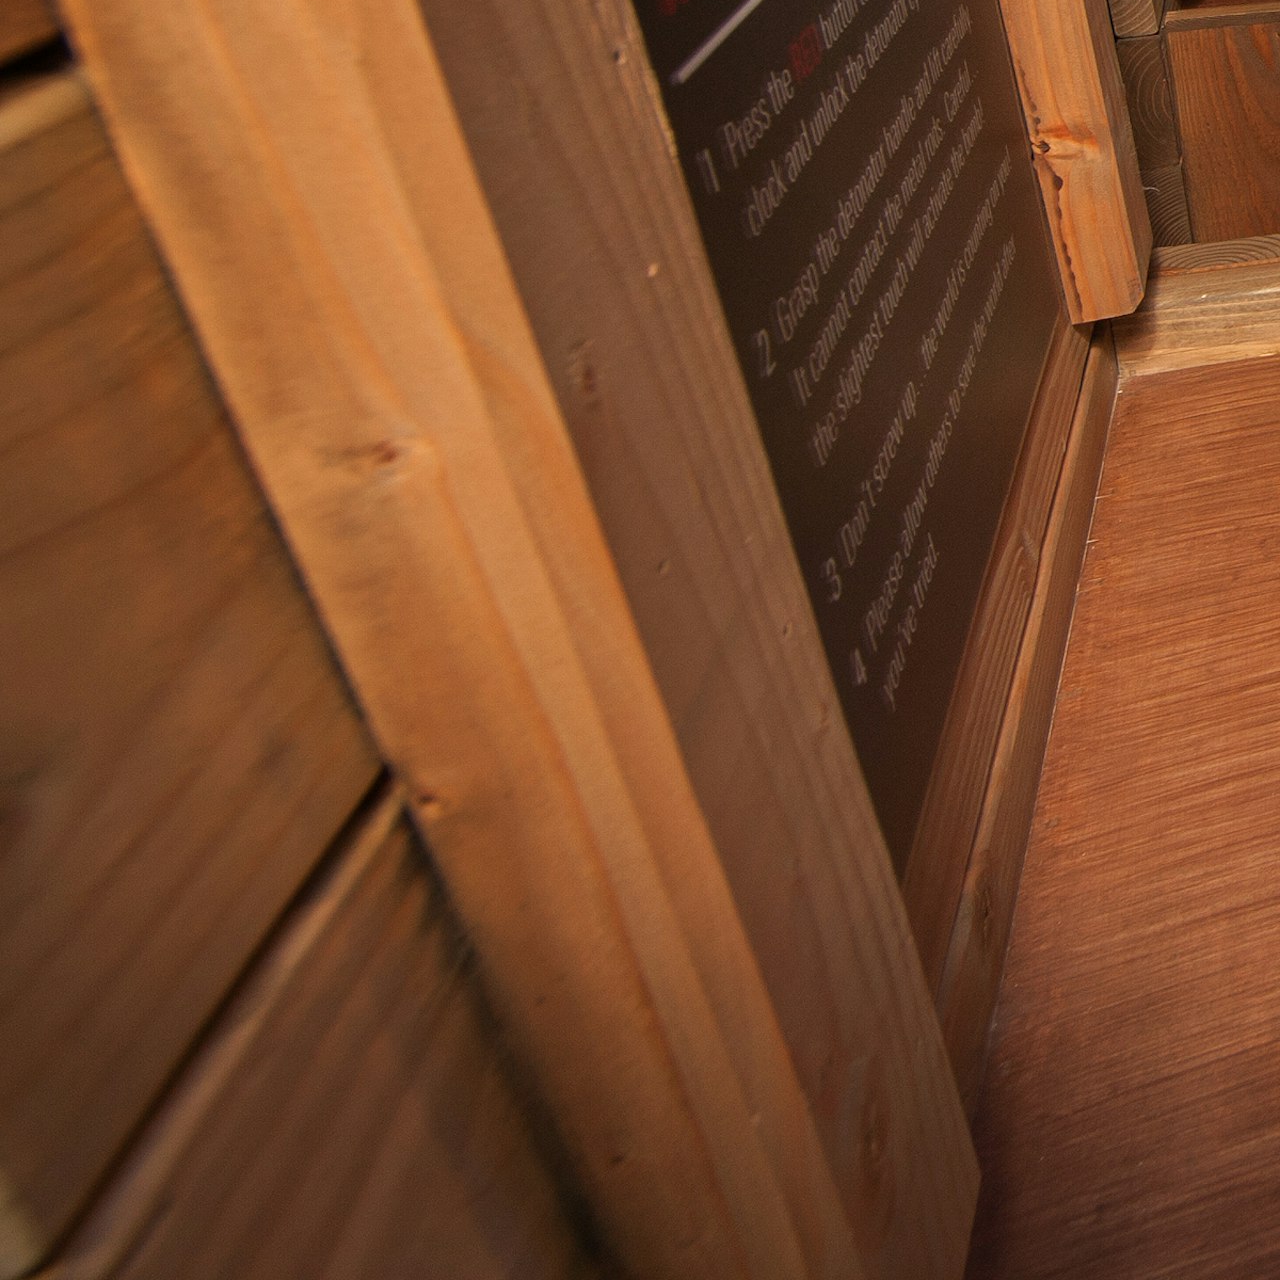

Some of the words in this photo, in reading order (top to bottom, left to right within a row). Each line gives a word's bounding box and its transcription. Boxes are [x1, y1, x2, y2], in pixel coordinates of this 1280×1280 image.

[722, 96, 772, 169] Press
[766, 69, 795, 116] the
[746, 158, 789, 237] clock
[783, 118, 813, 184] and
[808, 70, 851, 147] unlock
[845, 55, 868, 95] the
[756, 328, 776, 380] 2
[776, 261, 820, 344] Grasp
[815, 232, 840, 275] the
[837, 144, 887, 241] detonator
[883, 92, 916, 160] handle
[914, 61, 932, 110] and
[808, 289, 852, 384] cannot
[848, 216, 889, 306] contact
[884, 193, 904, 235] the
[900, 141, 926, 208] metal
[811, 412, 840, 468] the
[836, 311, 884, 421] slightest
[879, 257, 909, 326] touch
[904, 218, 926, 273] will
[922, 168, 954, 240] activate
[950, 141, 966, 179] the
[824, 556, 843, 602] 3
[872, 411, 904, 492] screw
[920, 324, 940, 371] the
[935, 267, 961, 337] world
[956, 257, 967, 282] is
[963, 198, 994, 270] counting
[865, 550, 905, 654] Please
[900, 478, 929, 559] allow
[925, 412, 953, 489] others
[949, 386, 961, 422] to
[958, 344, 977, 398] save
[972, 314, 988, 354] the
